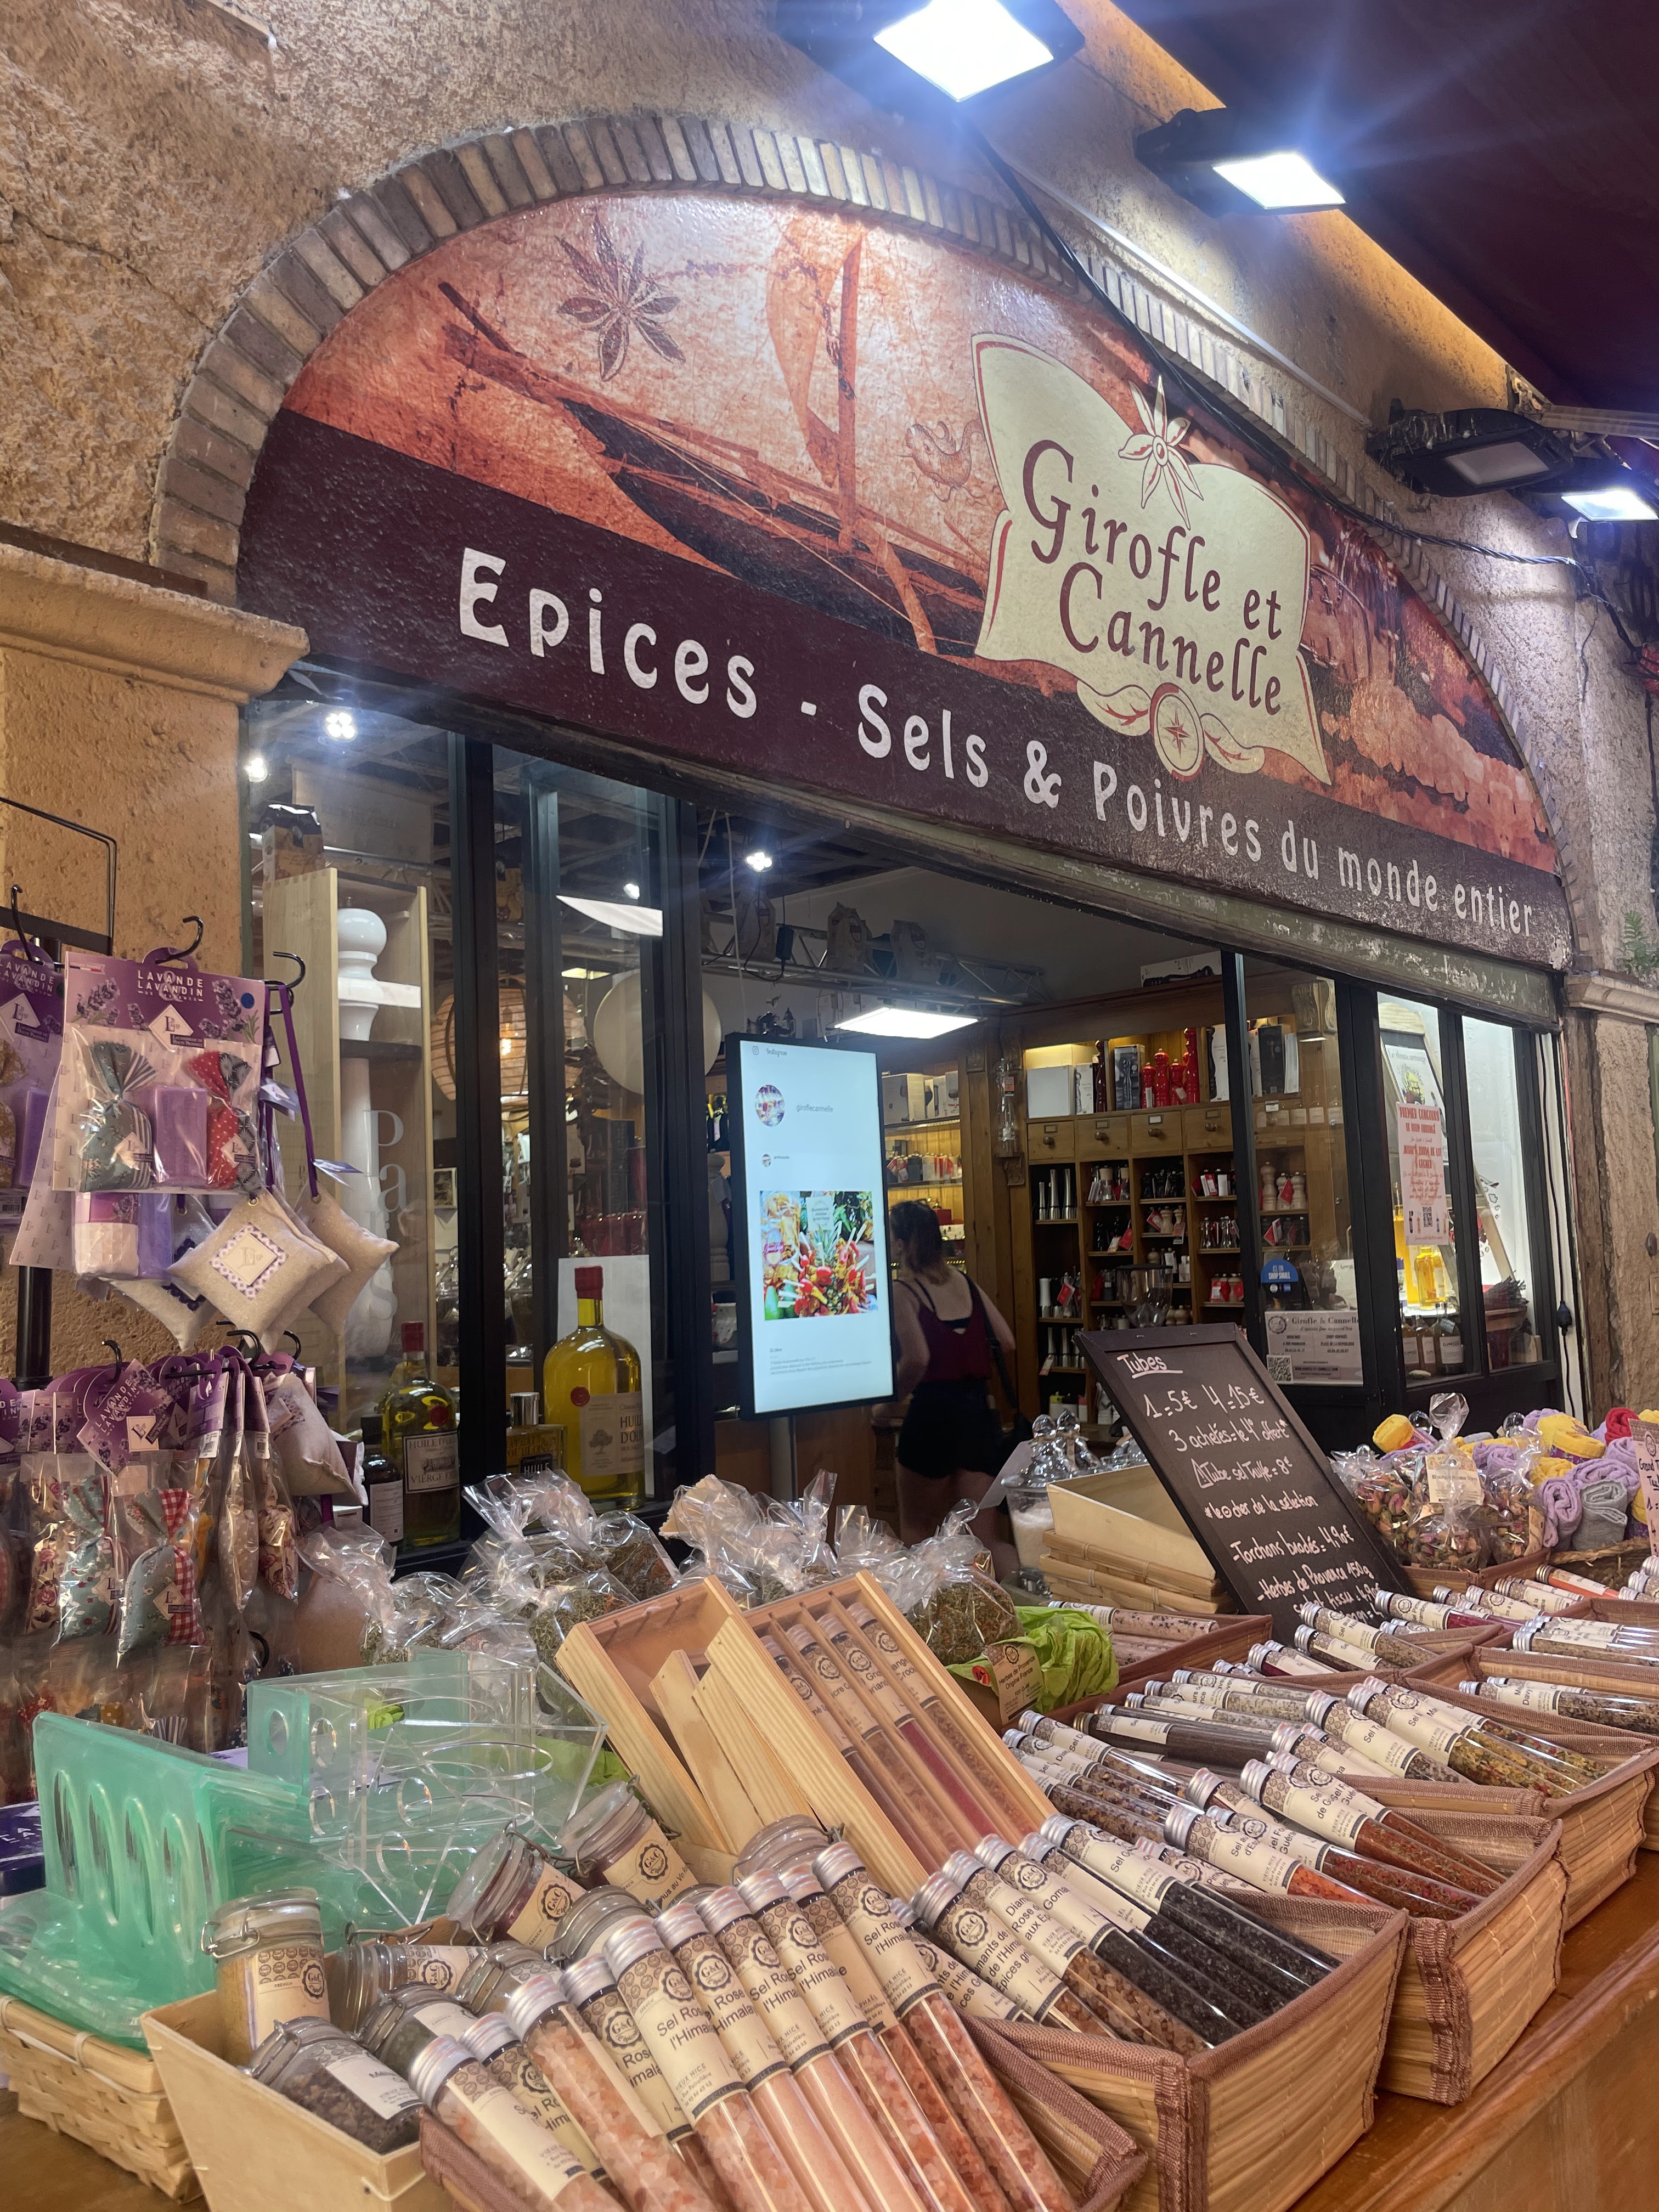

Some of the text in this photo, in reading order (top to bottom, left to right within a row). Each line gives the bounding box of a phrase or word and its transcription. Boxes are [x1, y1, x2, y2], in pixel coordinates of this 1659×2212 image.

[1023, 439, 1282, 640] Girofle et
[1059, 562, 1282, 716] Cannelle
[460, 547, 757, 719] Epices
[858, 684, 988, 788] Sels
[1024, 741, 1062, 808] &
[1093, 761, 1262, 862] Poivres
[1282, 820, 1318, 880] du
[1339, 847, 1438, 911] monde
[1454, 884, 1532, 937] entier
[0, 970, 53, 992] AVANDIN
[138, 970, 203, 988] LAVANDE
[138, 980, 203, 997] LAVANDIN
[1279, 1271, 1290, 1279] SMALL
[1116, 1352, 1167, 1374] Tubes
[95, 1379, 132, 1427] LAVANDE
[409, 1438, 437, 1448] HUILE
[1169, 1429, 1188, 1452] 3
[1018, 1656, 1035, 1672] Provence
[1363, 1726, 1376, 1743] Sel
[644, 1848, 662, 1869] G&C
[1231, 1844, 1244, 1858] Sel
[1110, 1856, 1124, 1873] Sel
[546, 1888, 563, 1911] G&C
[1043, 1886, 1070, 1910] Goma
[960, 1915, 979, 1936] G&C
[1011, 1908, 1034, 1933] Rose
[1025, 1921, 1042, 1941] aux
[864, 1928, 880, 1946] Sel
[997, 1930, 1008, 1942] de
[701, 1961, 724, 1979] G&C
[787, 1960, 806, 1981] Sel
[989, 1963, 1001, 1977] de
[714, 1988, 745, 2010] Rose
[749, 1979, 771, 2001] Sel
[657, 2013, 679, 2037] Sel
[690, 2063, 707, 2078] NICE
